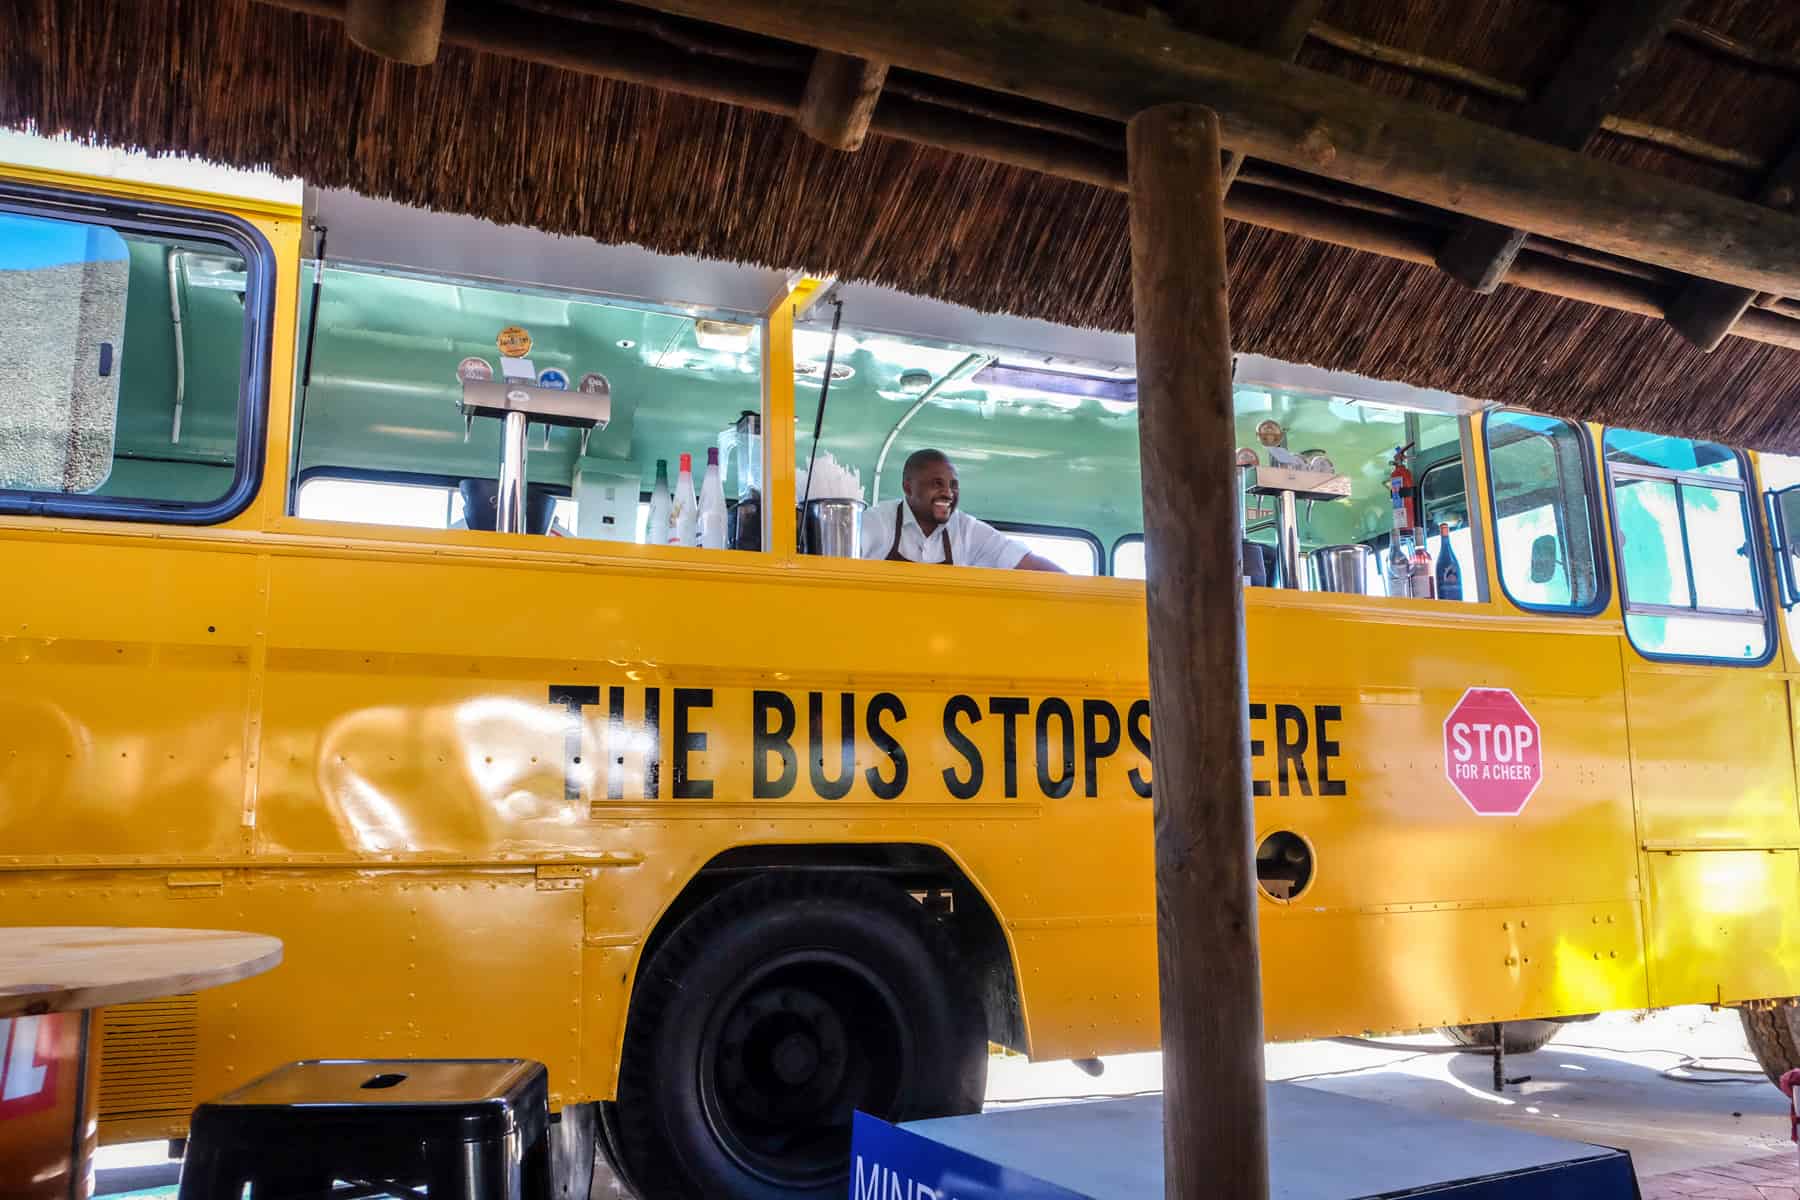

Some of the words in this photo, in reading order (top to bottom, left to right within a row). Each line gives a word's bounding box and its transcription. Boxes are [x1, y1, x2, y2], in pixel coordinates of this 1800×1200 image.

[548, 685, 714, 800] THE
[752, 690, 909, 800] BUS
[1249, 703, 1347, 796] ERE
[1452, 722, 1533, 763] STOP
[1455, 763, 1478, 780] FOR
[1482, 764, 1490, 780] A
[1493, 764, 1532, 780] CHEER
